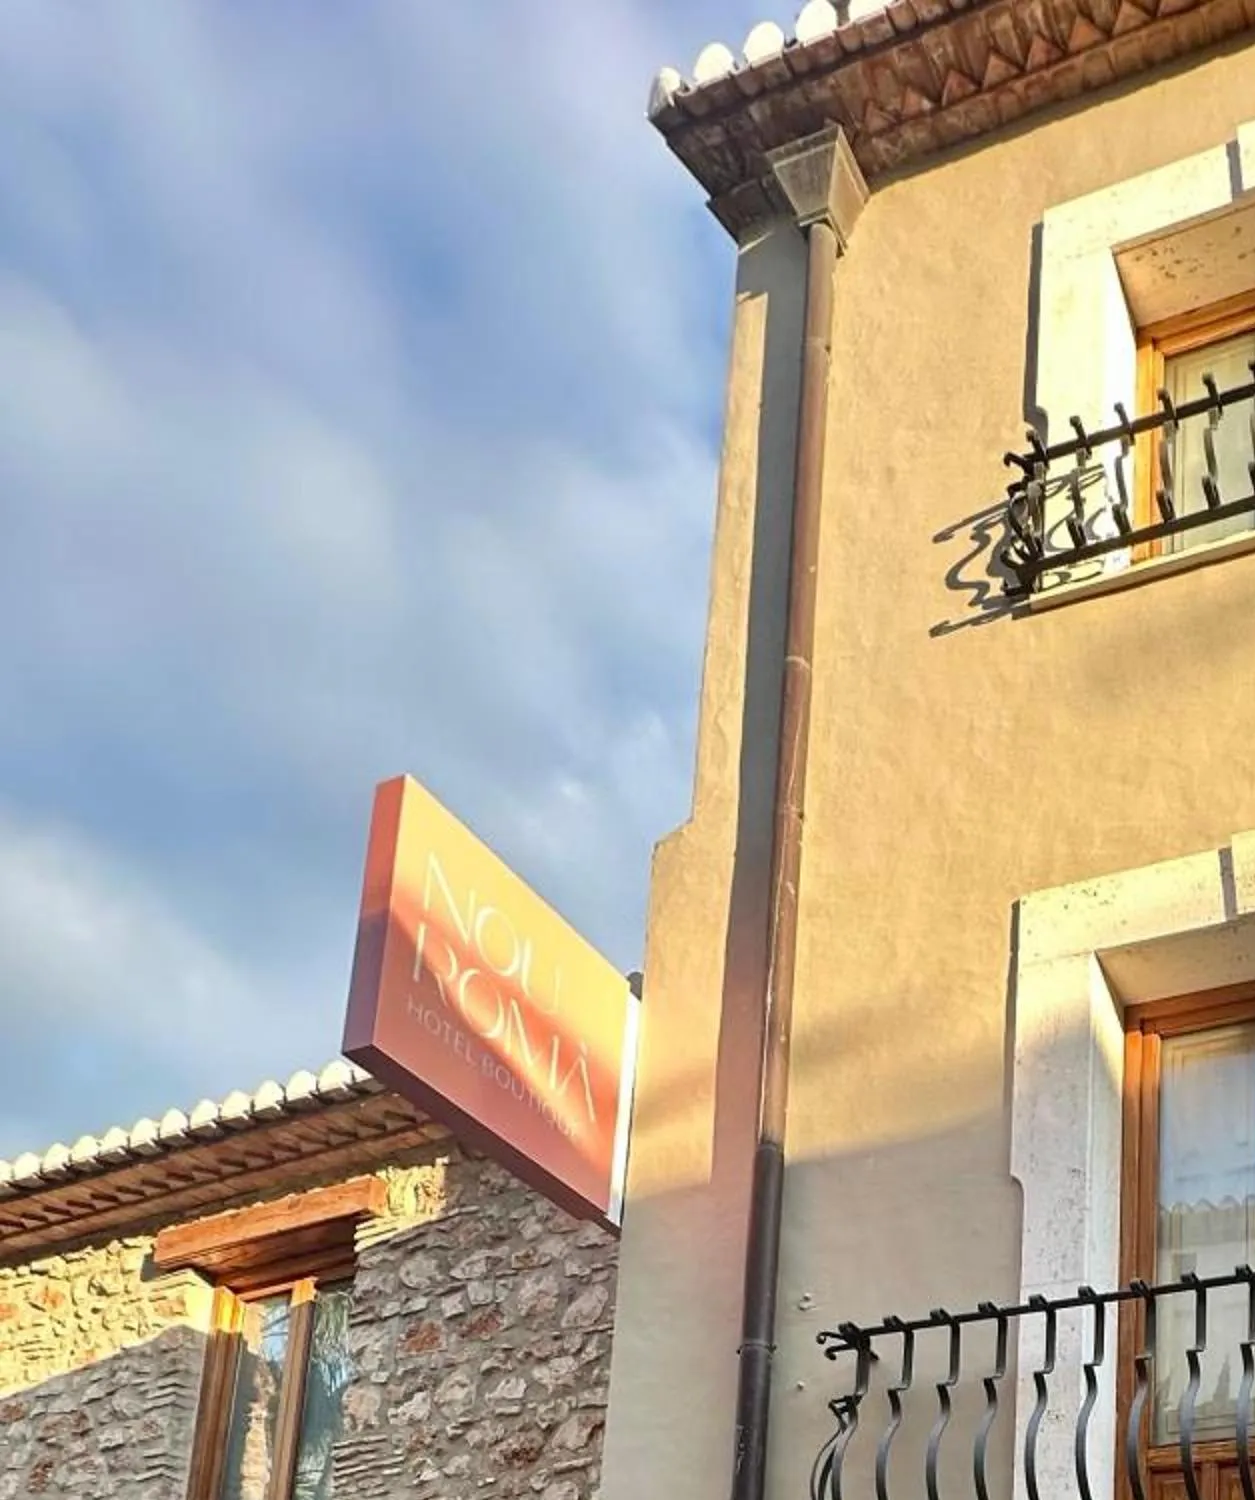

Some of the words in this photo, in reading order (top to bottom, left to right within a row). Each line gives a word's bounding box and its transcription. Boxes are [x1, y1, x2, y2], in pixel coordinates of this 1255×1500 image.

[423, 851, 562, 1015] NOU
[407, 993, 477, 1069] HOTEL
[412, 920, 596, 1123] ROMÀ
